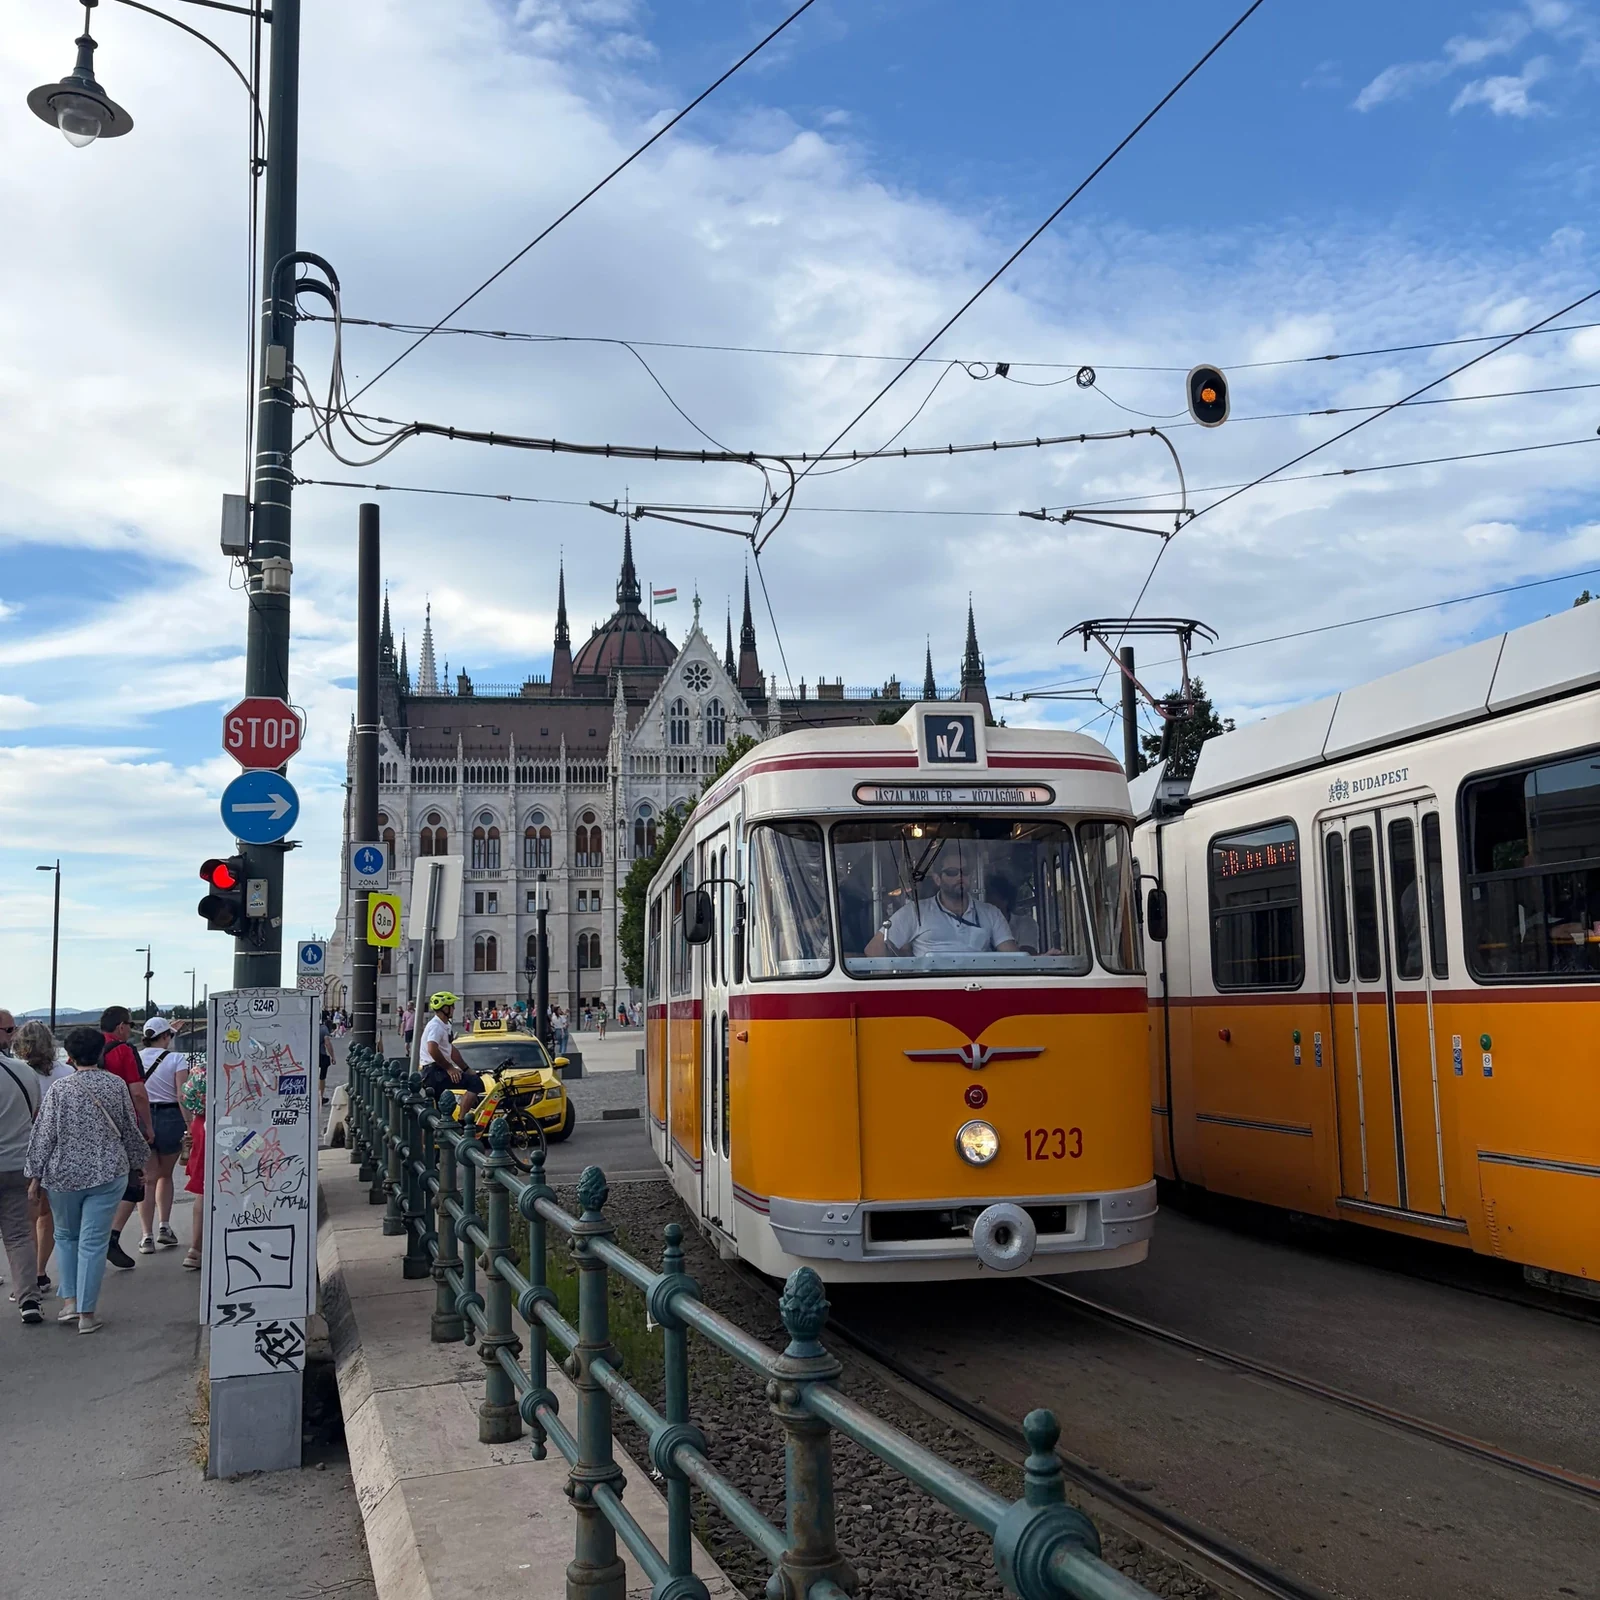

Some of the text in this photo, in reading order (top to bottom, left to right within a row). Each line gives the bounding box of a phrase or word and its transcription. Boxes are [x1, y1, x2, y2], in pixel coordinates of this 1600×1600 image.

[228, 717, 296, 749] STOP
[936, 720, 966, 758] N2
[1352, 767, 1409, 793] BUDAPEST
[253, 1000, 274, 1012] 524R
[482, 1020, 500, 1028] TAXI
[1024, 1127, 1083, 1161] 1233
